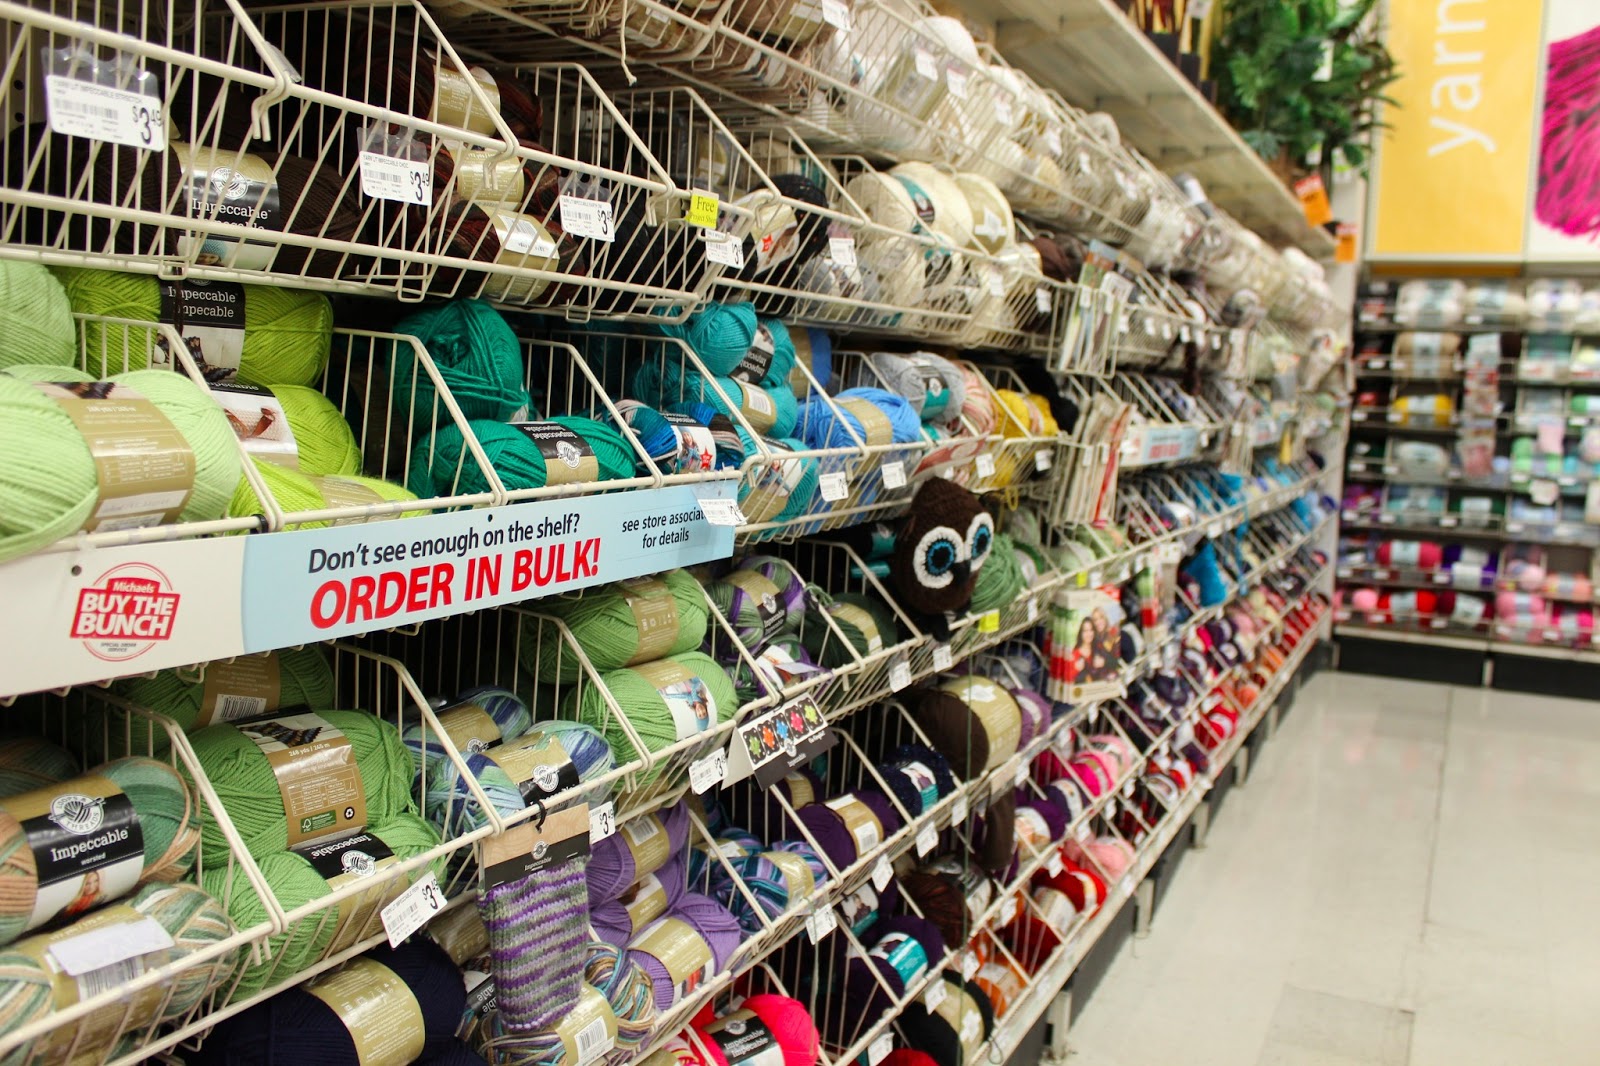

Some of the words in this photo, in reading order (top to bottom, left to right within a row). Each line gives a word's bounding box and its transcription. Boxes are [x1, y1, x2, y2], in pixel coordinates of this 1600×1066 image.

[1426, 0, 1496, 157] yarn
[696, 196, 715, 213] Free
[622, 519, 640, 533] see
[642, 515, 667, 530] store
[669, 507, 706, 525] associat
[308, 542, 370, 574] Don't
[372, 544, 406, 564] see
[410, 527, 479, 558] enough
[483, 528, 504, 547] on
[508, 520, 534, 543] the
[536, 512, 580, 539] shelf?
[642, 533, 657, 549] for
[658, 526, 690, 546] details
[112, 580, 155, 594] Michaels
[310, 562, 455, 630] ORDER
[463, 553, 503, 602] IN
[511, 537, 601, 593] BULK!
[81, 592, 133, 614] BUY
[132, 596, 176, 616] THE
[75, 613, 170, 637] BUNCH
[55, 796, 79, 810] LOOPS
[65, 811, 100, 830] THREADS
[50, 829, 128, 862] Impeccable
[311, 833, 373, 859] Impeccable
[724, 1029, 765, 1050] Impeccable
